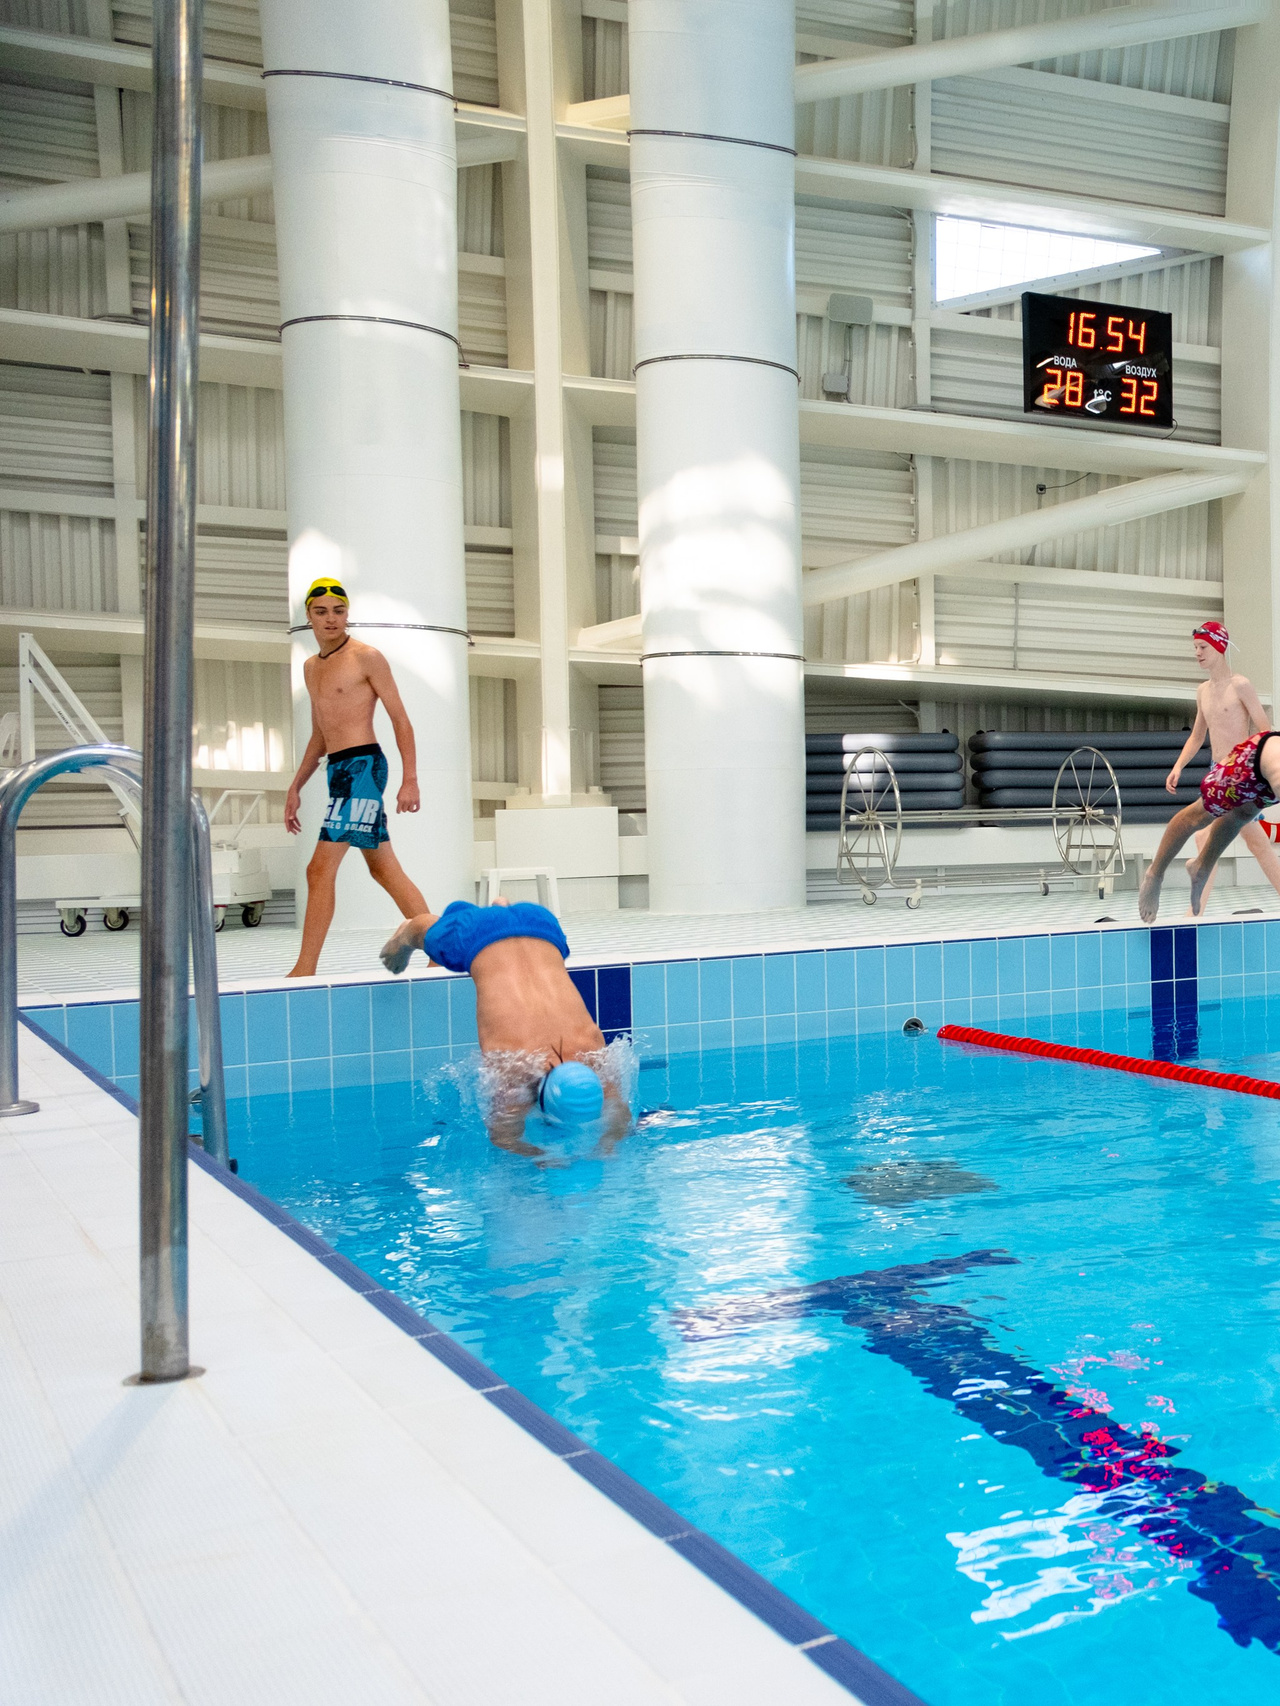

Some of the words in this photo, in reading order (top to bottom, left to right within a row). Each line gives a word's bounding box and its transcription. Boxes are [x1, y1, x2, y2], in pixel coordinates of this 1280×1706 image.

[1054, 355, 1077, 369] ВОДА
[1125, 365, 1157, 378] ВОЗДУХ
[1042, 368, 1084, 407] 28
[1120, 377, 1158, 416] 32
